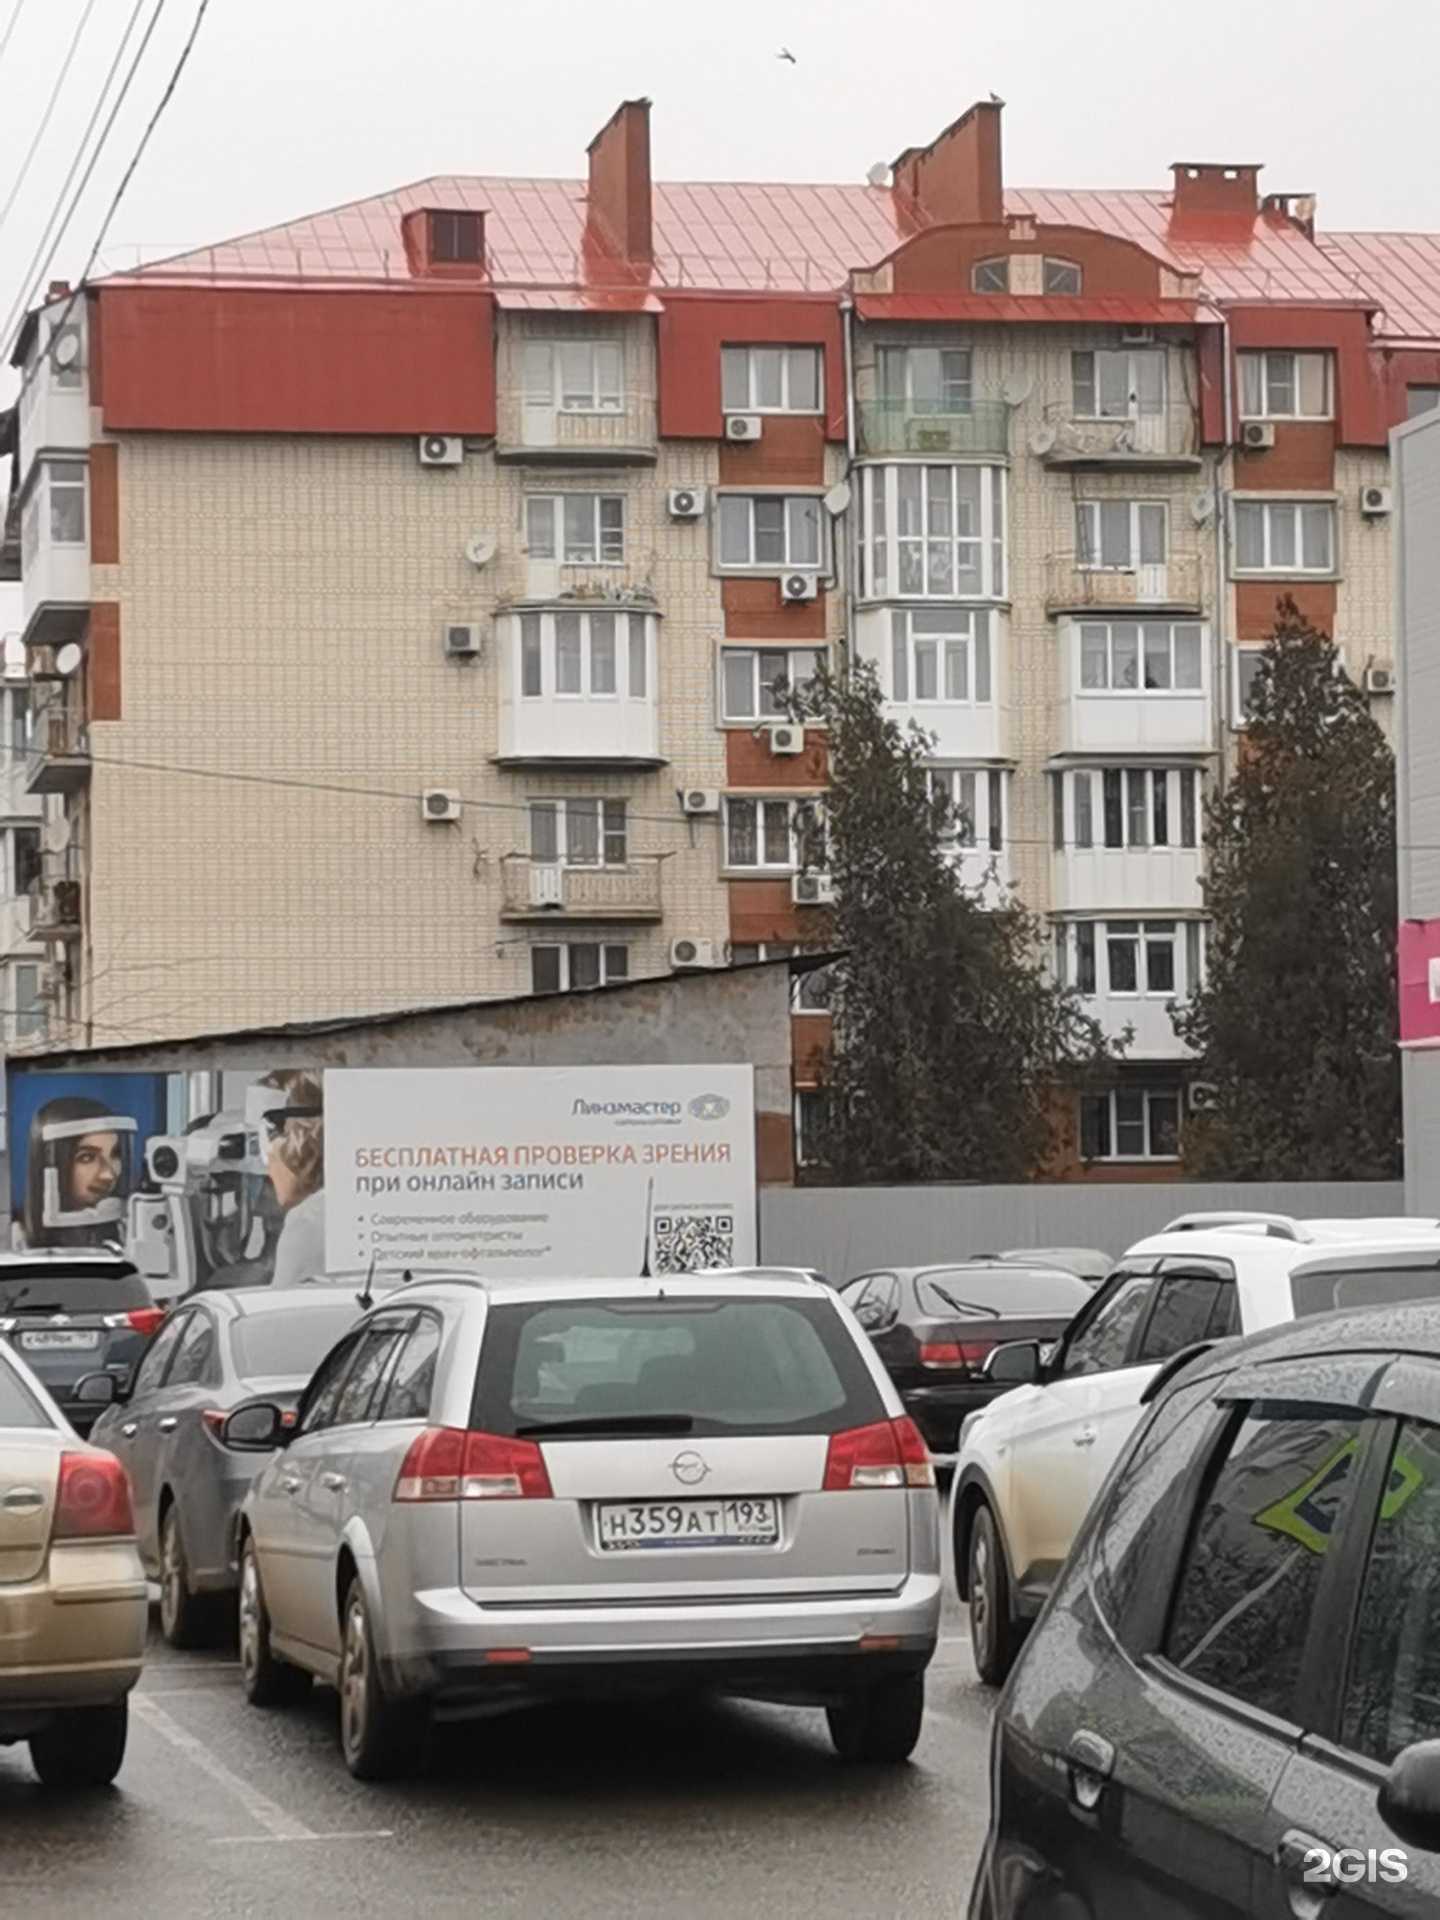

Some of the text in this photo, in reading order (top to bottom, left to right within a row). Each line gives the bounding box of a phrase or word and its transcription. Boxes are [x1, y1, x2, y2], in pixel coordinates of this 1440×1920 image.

[355, 1142, 731, 1168] БЕСПЛАТНАЯ ПРОВЕРКА ЗРЕНИЯ
[355, 1170, 584, 1196] при онлайн записи
